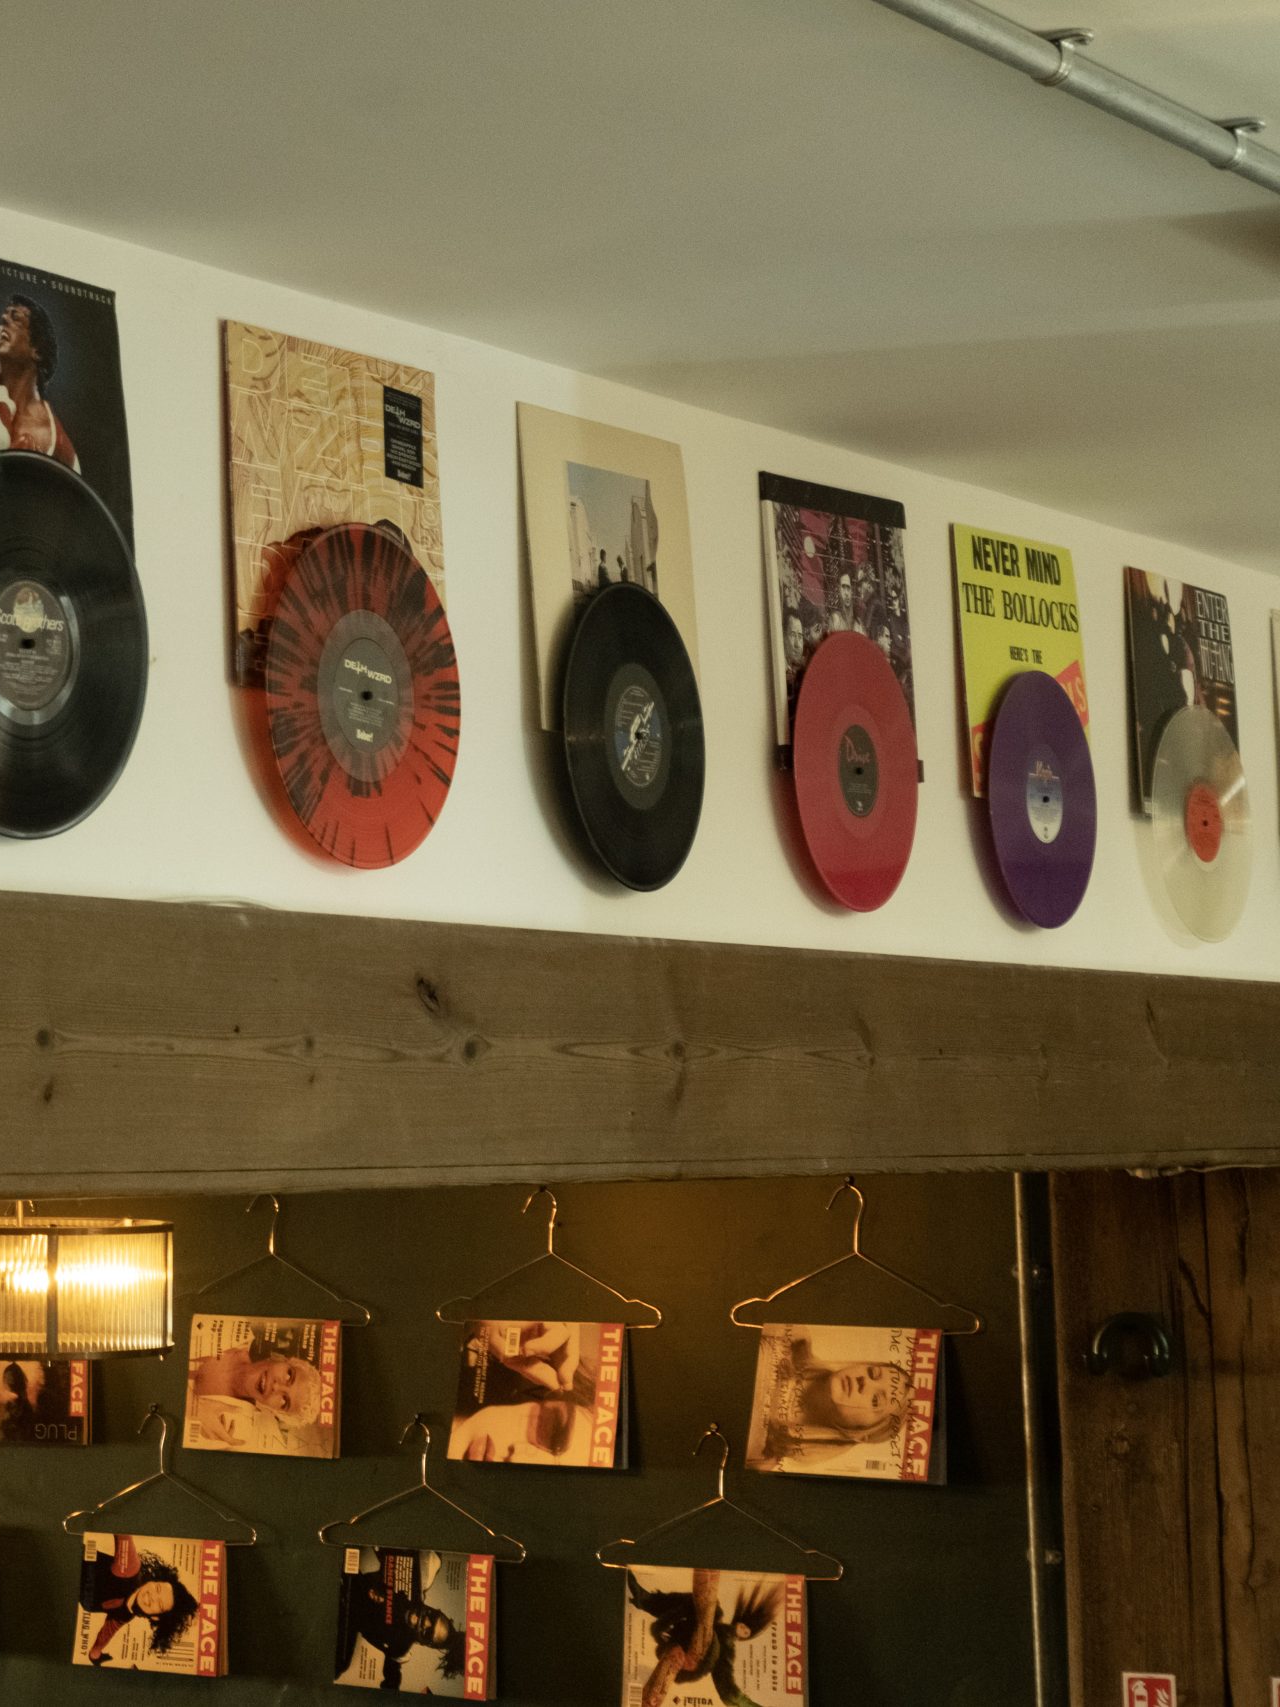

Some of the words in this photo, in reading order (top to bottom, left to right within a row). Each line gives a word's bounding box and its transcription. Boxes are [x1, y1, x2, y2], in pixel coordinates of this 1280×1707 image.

[971, 534, 1021, 578] NEVER
[1025, 547, 1062, 586] MIND
[962, 582, 996, 617] THE
[1001, 590, 1080, 633] BOLLOCKS
[1195, 590, 1229, 624] ENTER
[1198, 620, 1230, 642] THE
[322, 1325, 337, 1366] THE
[600, 1328, 621, 1382] THE
[913, 1334, 938, 1390] THE
[71, 1362, 84, 1413] FACE
[320, 1372, 335, 1425] FACE
[35, 1423, 77, 1441] PLUG
[592, 1391, 616, 1465] FACE
[906, 1401, 932, 1477] FACE
[203, 1544, 219, 1595] THE
[470, 1559, 488, 1613] THE
[787, 1580, 802, 1624] THE
[200, 1604, 218, 1673] FACE
[467, 1621, 485, 1695] FACE
[786, 1630, 802, 1691] FACE
